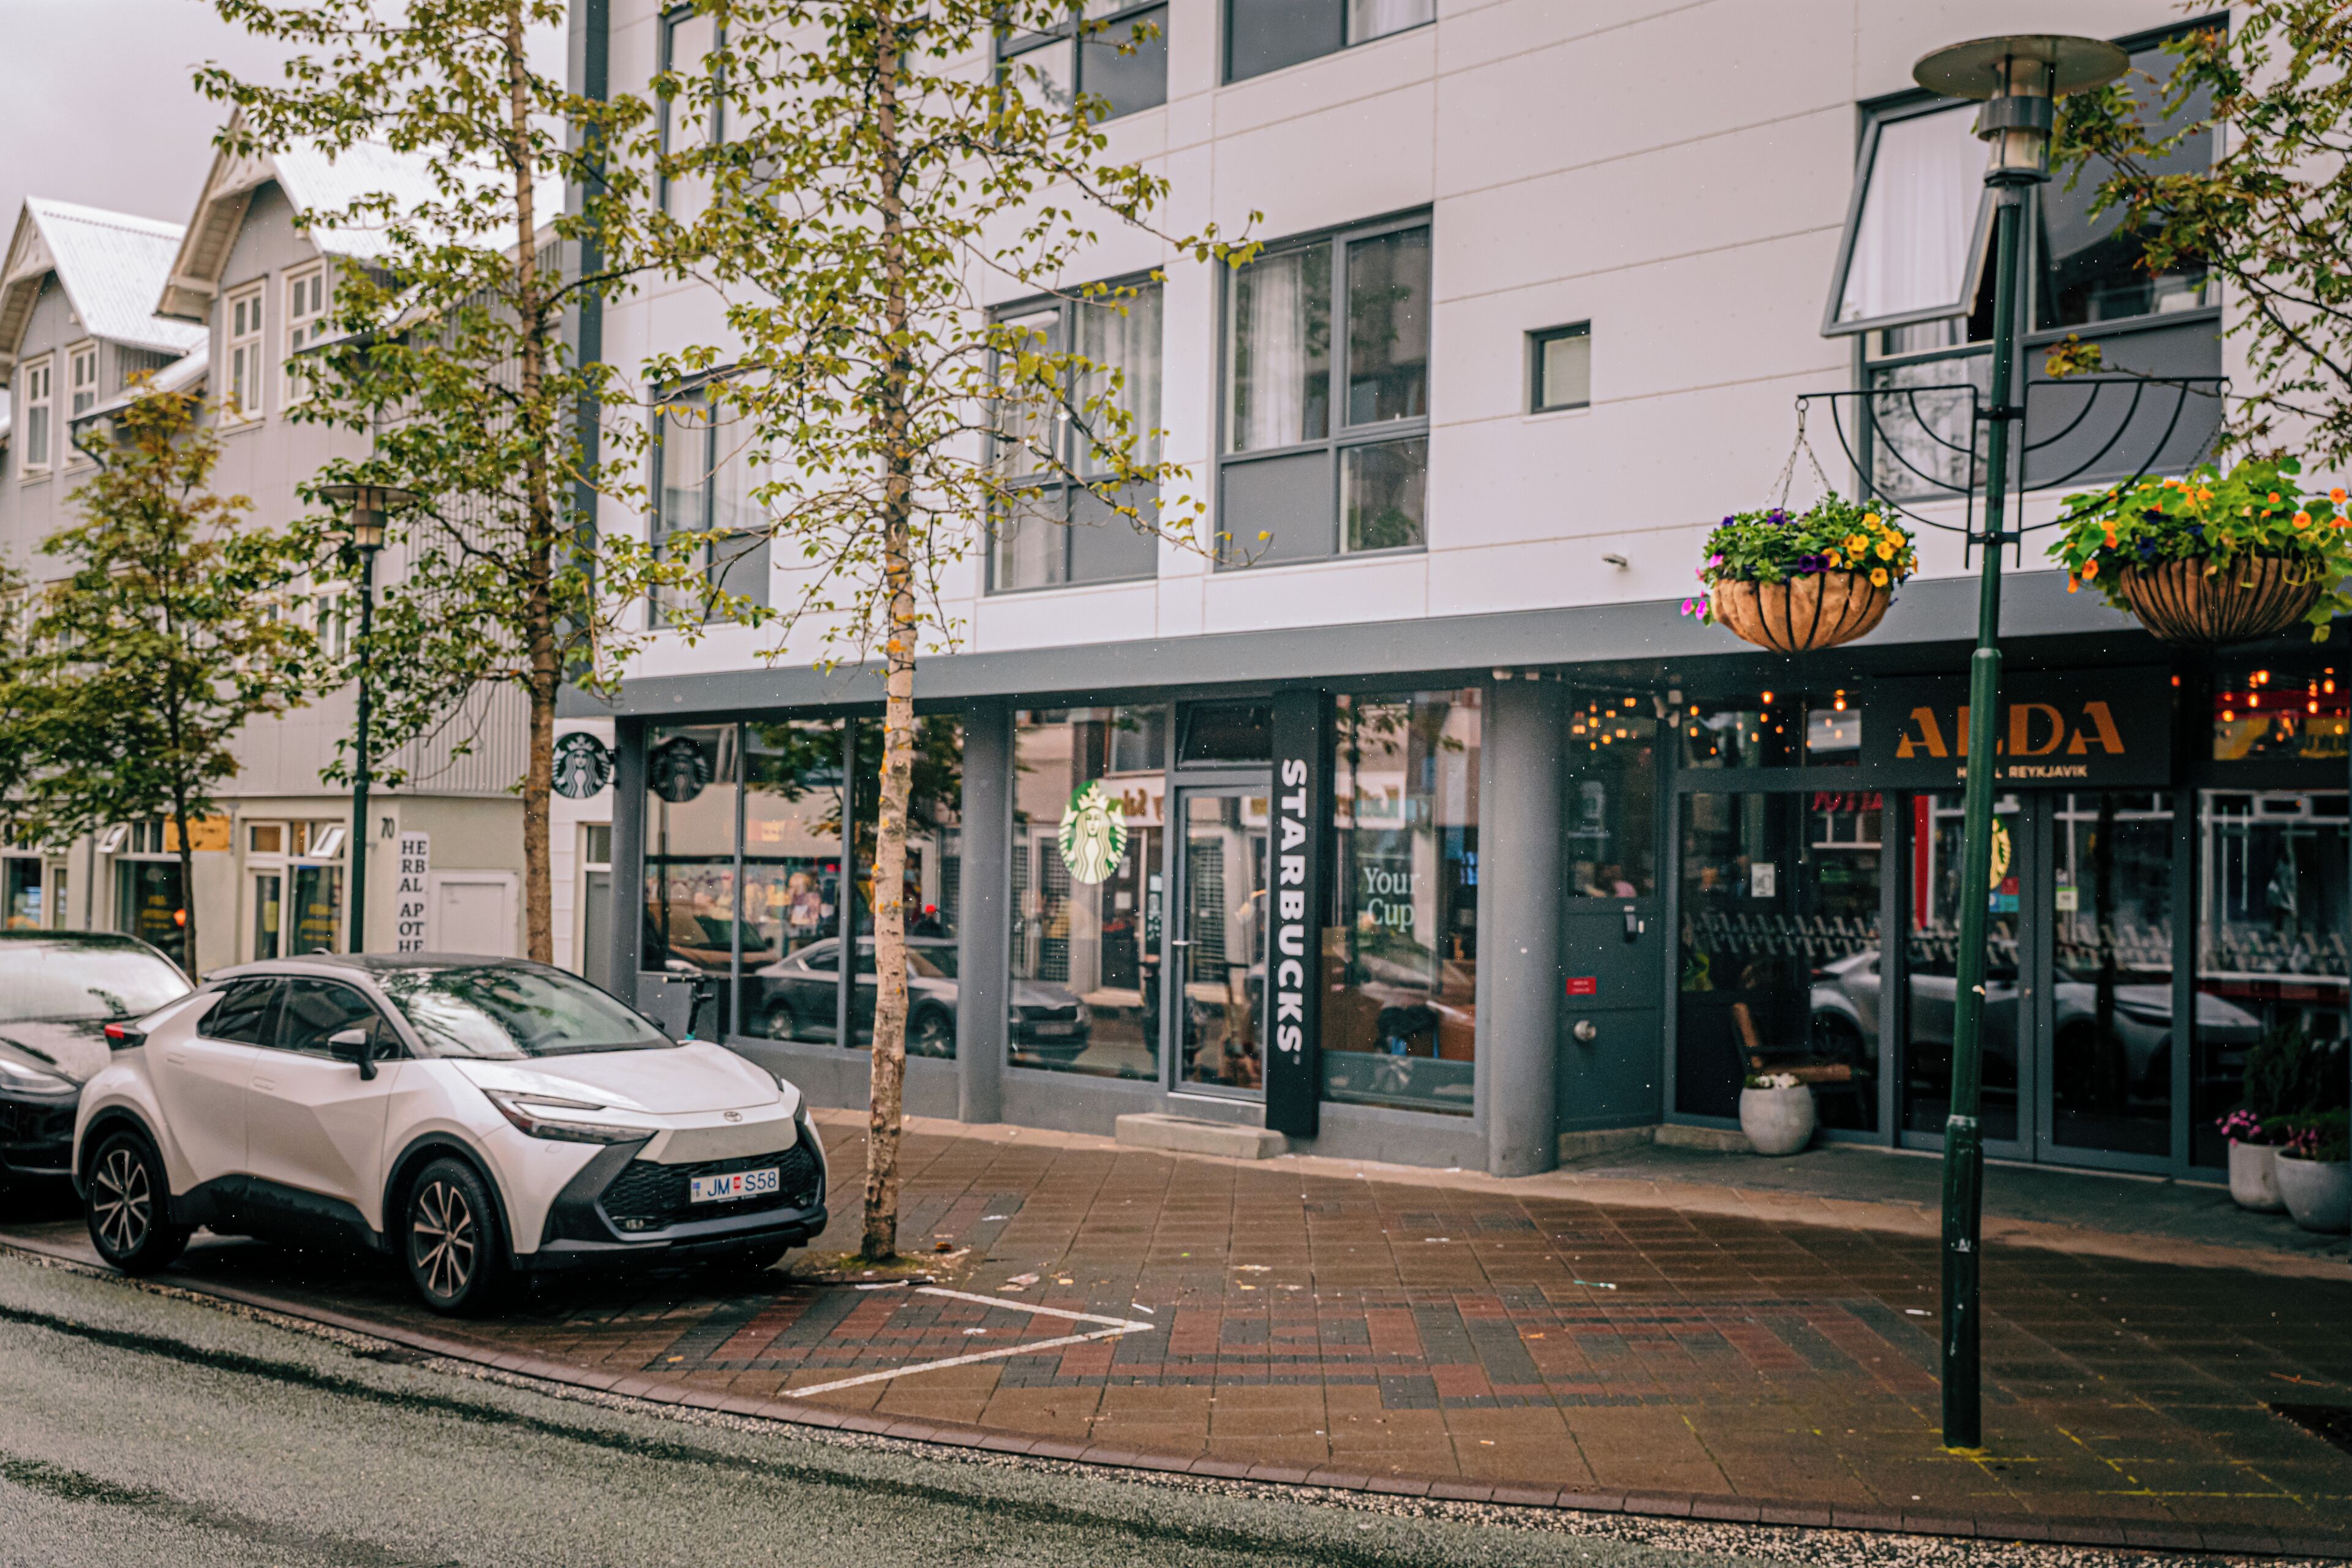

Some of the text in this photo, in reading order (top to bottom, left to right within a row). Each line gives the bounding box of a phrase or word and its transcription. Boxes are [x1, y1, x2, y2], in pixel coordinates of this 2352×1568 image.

[2008, 766, 2088, 778] REYKJAVIK
[381, 817, 395, 838] 70
[402, 840, 427, 855] HE
[402, 859, 425, 873] RB
[399, 877, 423, 892] AL
[1363, 867, 1421, 895] Your
[400, 903, 424, 918] AP
[1277, 759, 1307, 1052] STARBUCKS
[1367, 886, 1415, 933] Cup
[399, 921, 424, 937] OT
[707, 1177, 730, 1196] JM
[745, 1171, 777, 1191] S58
